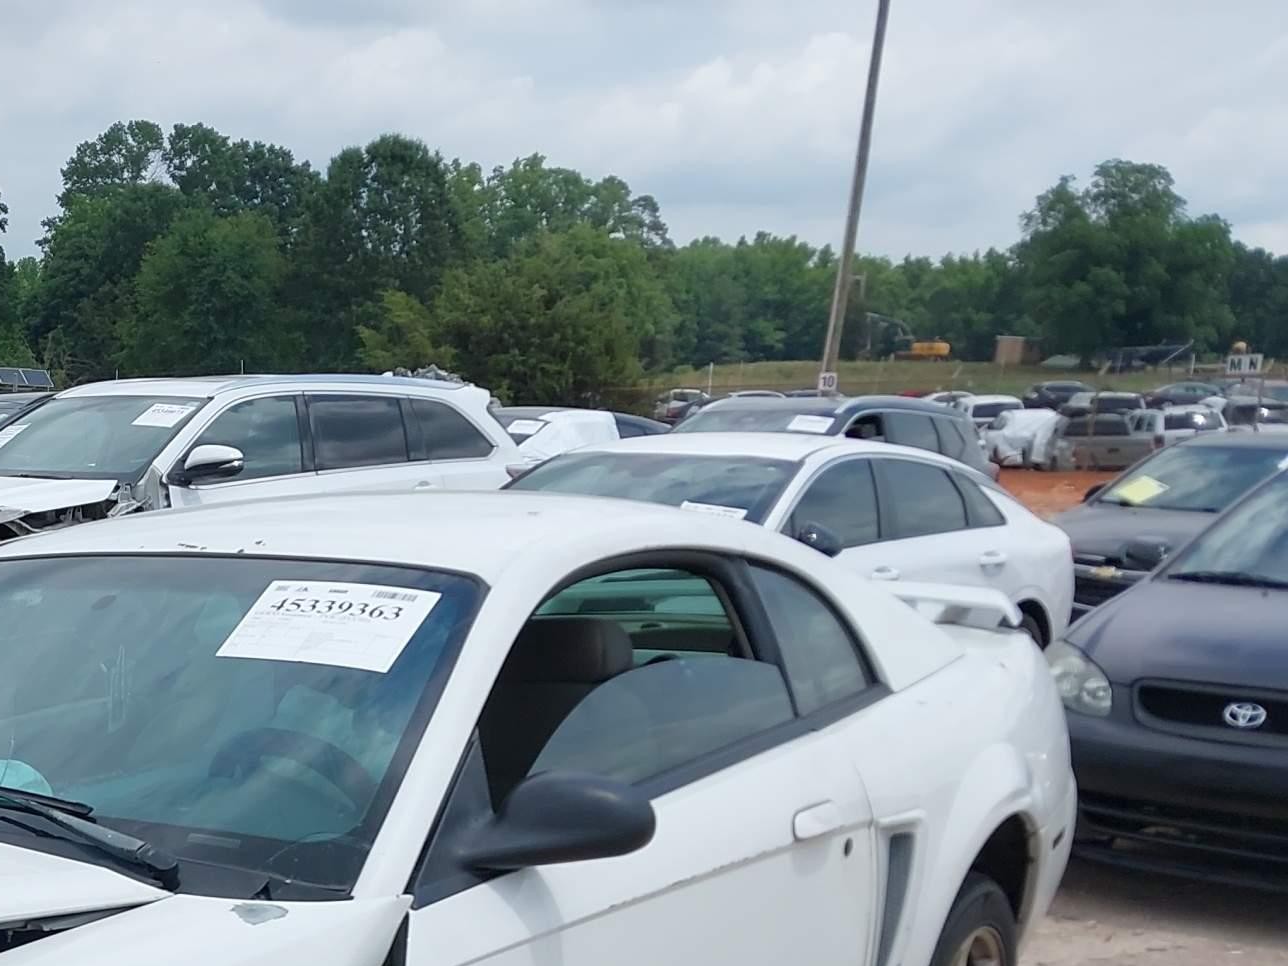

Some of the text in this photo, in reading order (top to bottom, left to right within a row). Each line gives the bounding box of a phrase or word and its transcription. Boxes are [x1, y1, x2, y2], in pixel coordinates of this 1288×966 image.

[1229, 357, 1258, 371] M N
[822, 374, 835, 388] 10
[270, 597, 404, 621] 45339363
